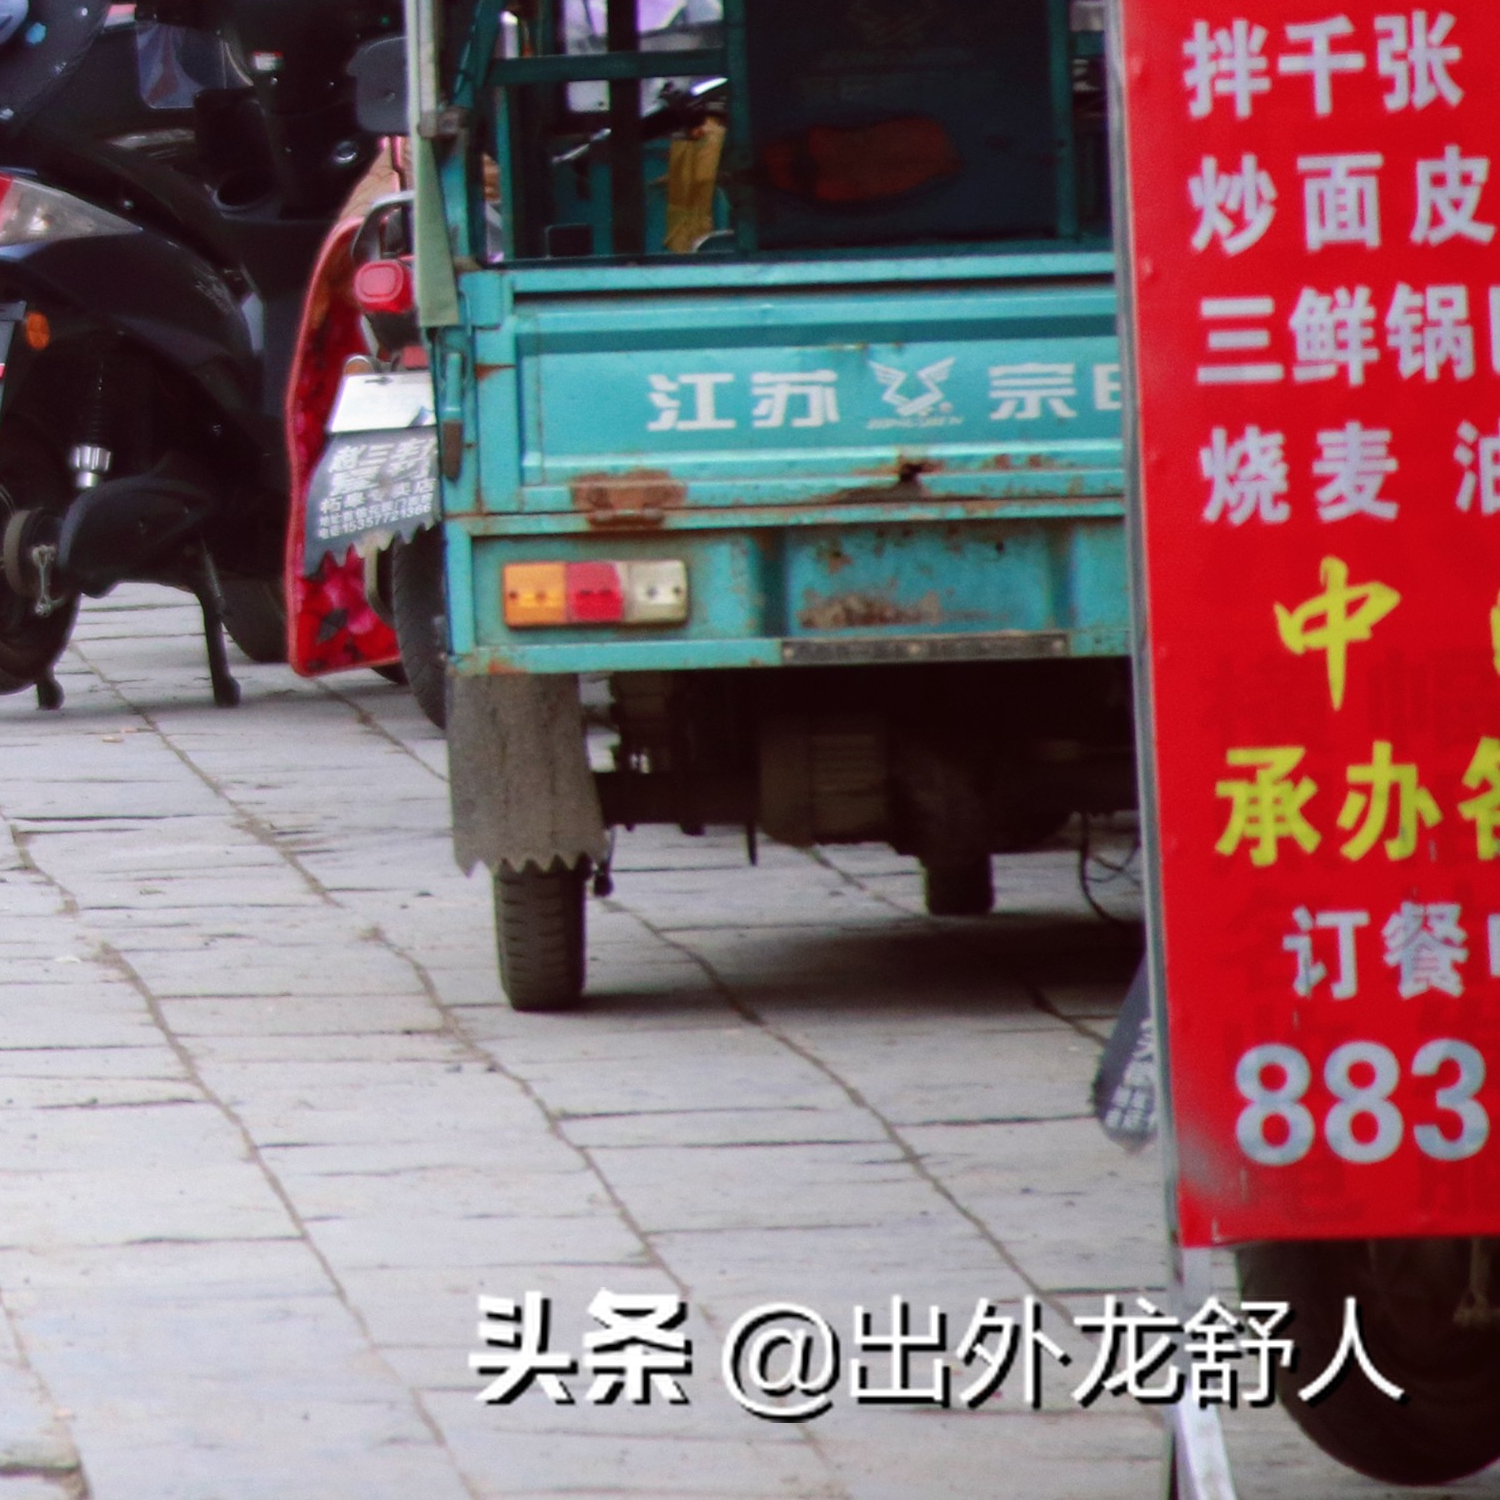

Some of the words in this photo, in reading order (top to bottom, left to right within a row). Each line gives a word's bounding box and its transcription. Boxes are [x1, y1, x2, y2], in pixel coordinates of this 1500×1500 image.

[1183, 10, 1464, 118] 拌千张
[1189, 146, 1496, 256] 炒面皮
[1197, 282, 1500, 387] 三鲜锅
[647, 370, 840, 432] 江苏
[1199, 421, 1398, 525] 烧麦
[1283, 901, 1500, 1000] 订餐
[1235, 1038, 1490, 1167] 883
